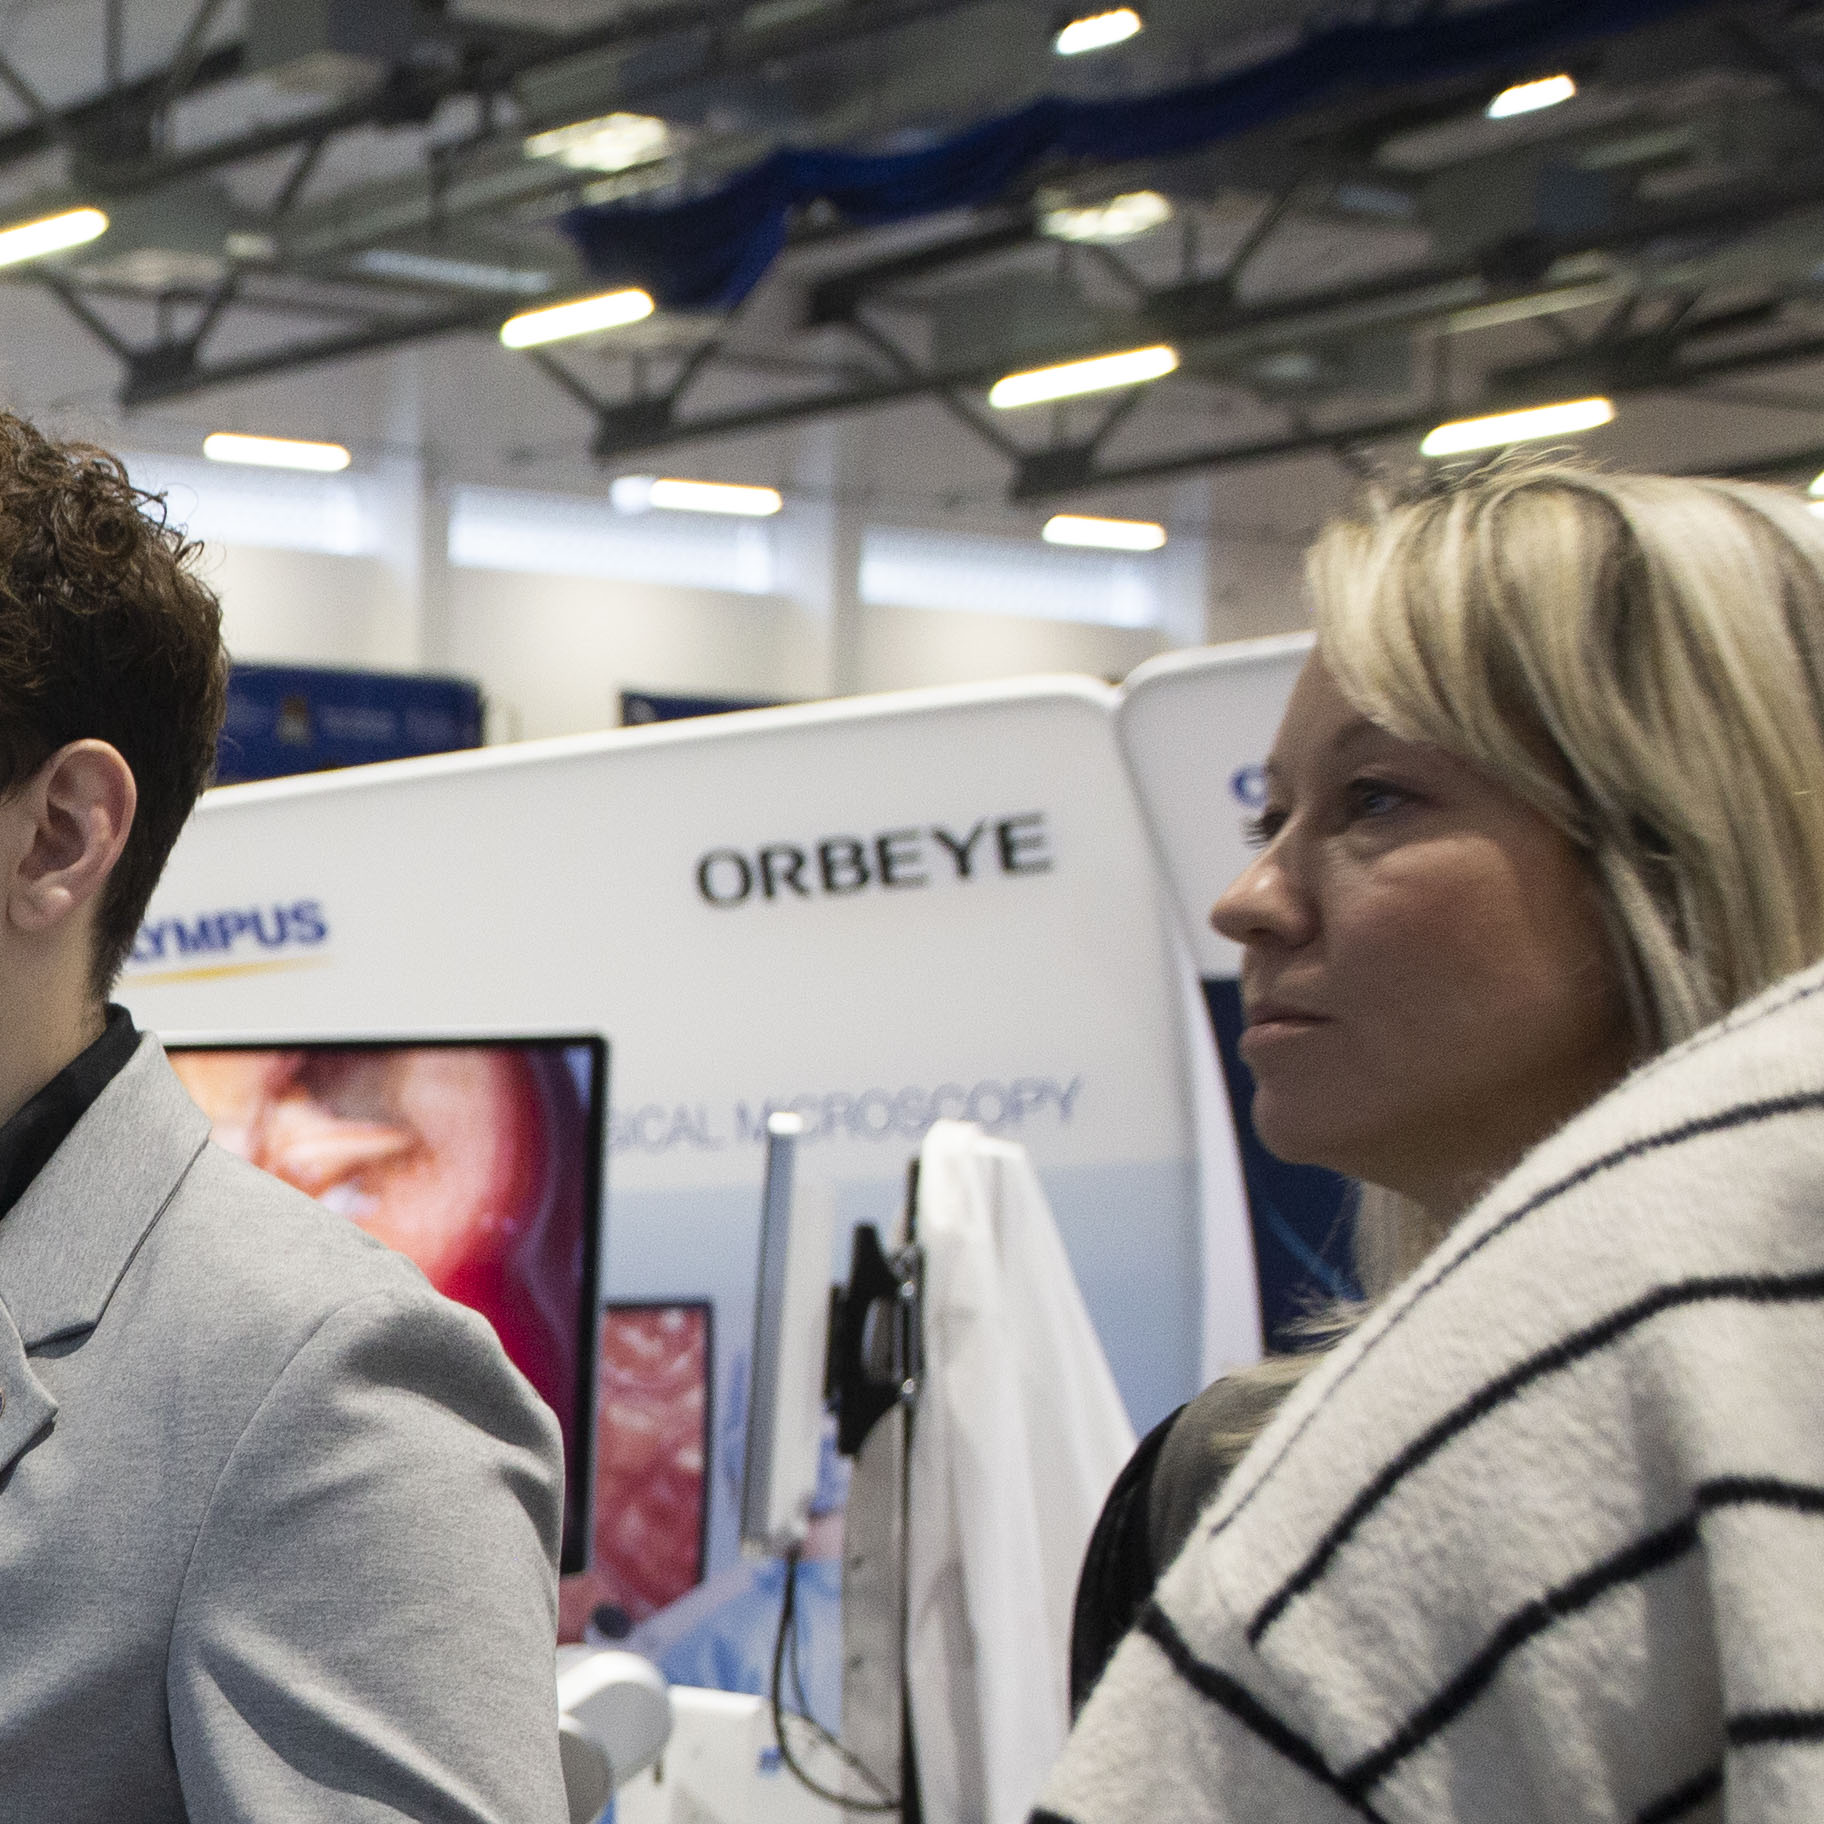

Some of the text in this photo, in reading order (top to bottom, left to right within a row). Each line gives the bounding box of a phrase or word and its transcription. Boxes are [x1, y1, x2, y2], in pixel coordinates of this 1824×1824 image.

[697, 811, 1054, 908] ORBEYE
[132, 898, 329, 962] YMPUS
[735, 1075, 1083, 1146] MCROSCOPY
